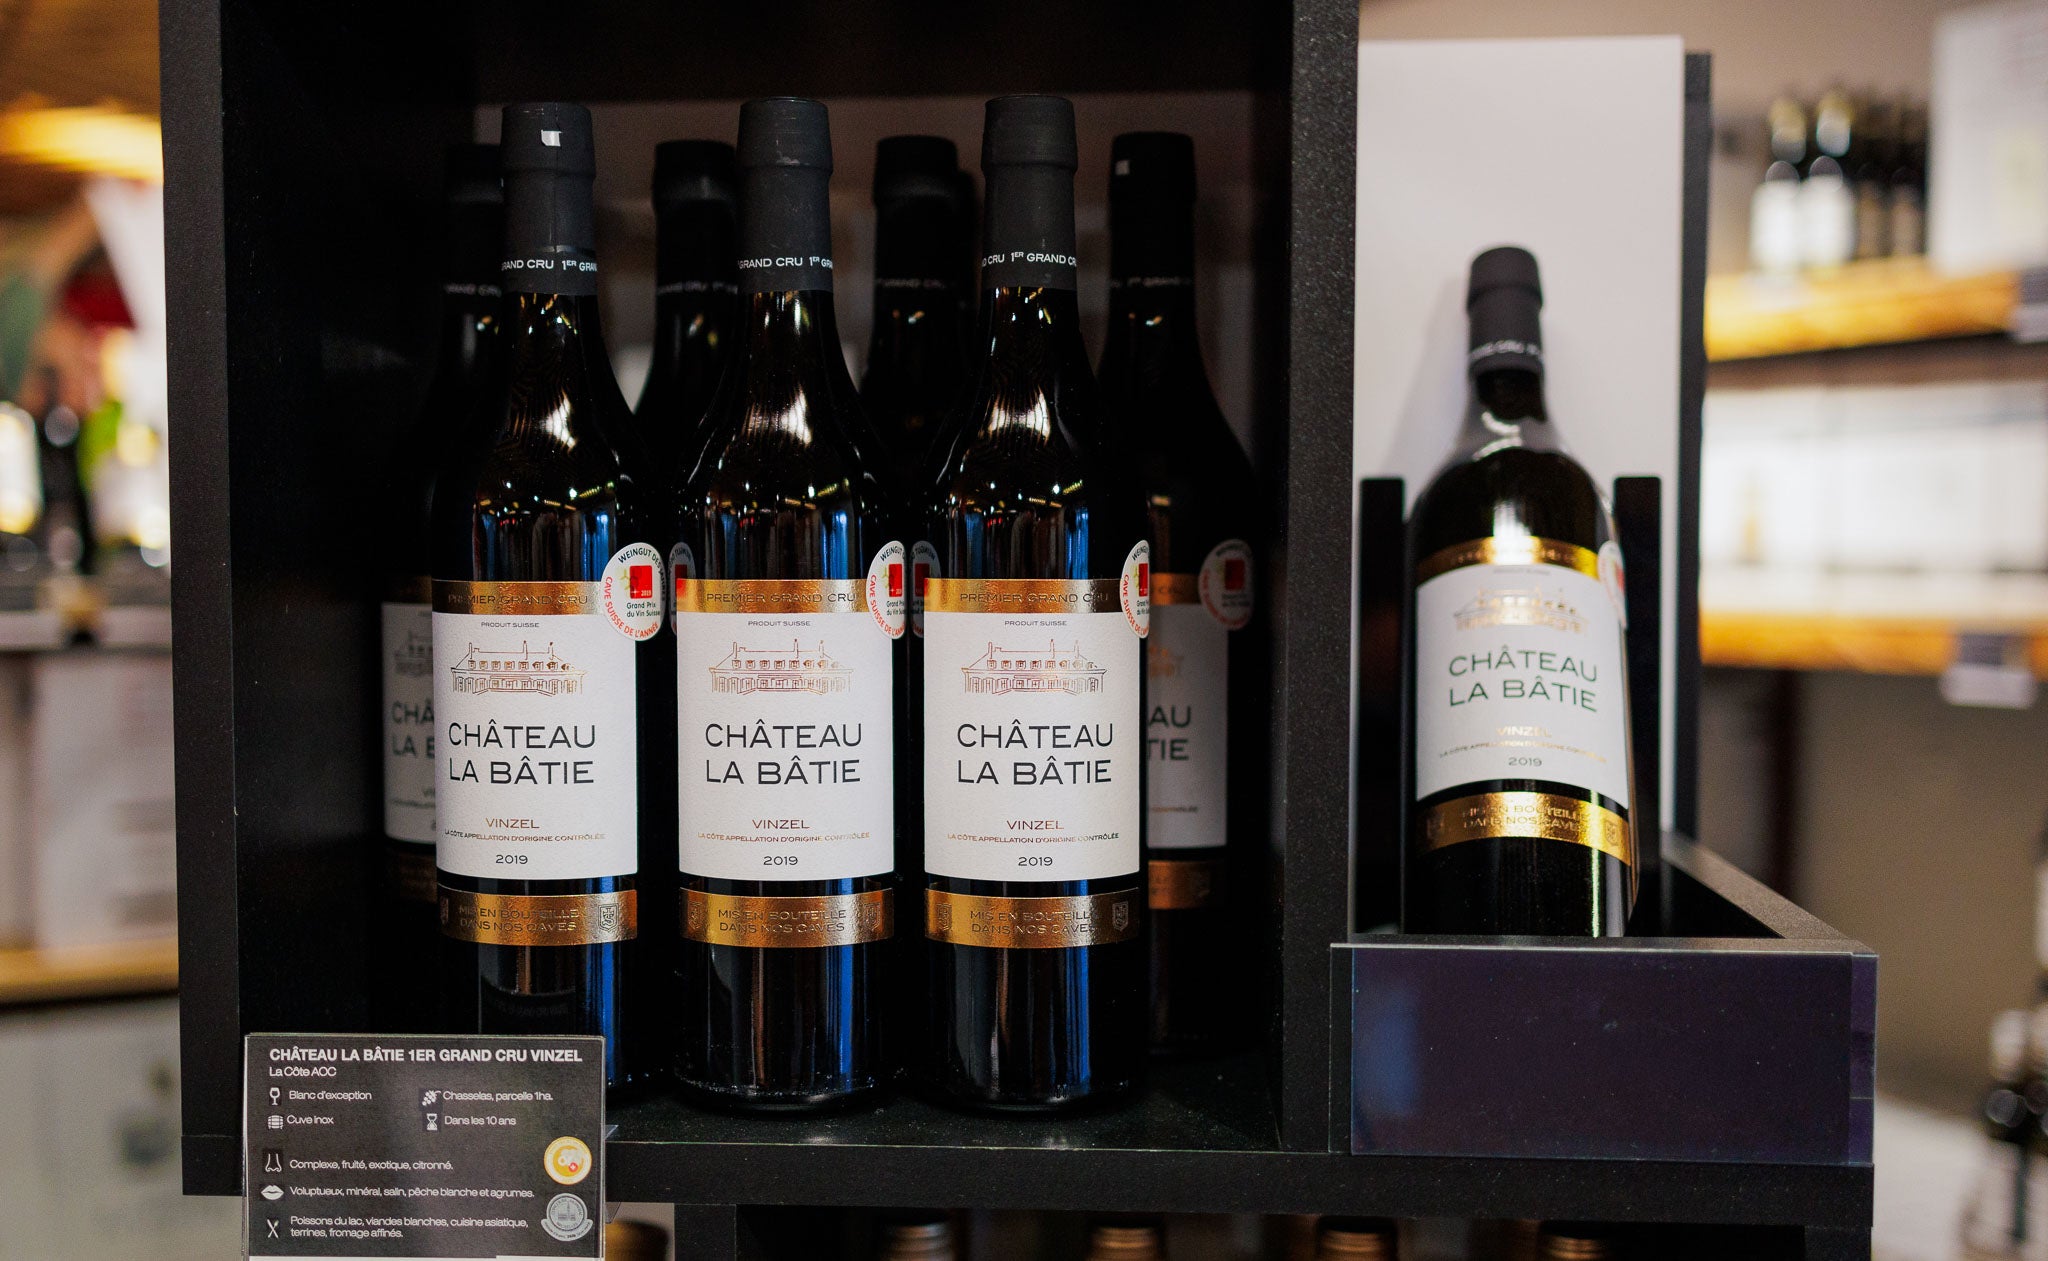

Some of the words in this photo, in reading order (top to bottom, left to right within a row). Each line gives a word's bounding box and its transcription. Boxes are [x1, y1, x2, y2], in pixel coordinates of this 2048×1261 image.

[739, 258, 772, 269] GRAND
[775, 257, 803, 266] CRU
[988, 254, 1004, 264] CRU
[1026, 253, 1066, 264] GRAND
[527, 260, 554, 269] CRU
[618, 548, 651, 563] WEINGUT
[604, 576, 612, 599] CAVE
[1122, 574, 1130, 597] CAVE
[500, 596, 550, 604] GRAND
[558, 595, 588, 604] CRU
[706, 593, 766, 603] PREMIER
[770, 594, 822, 603] GRAND
[827, 593, 856, 602] CRU
[960, 593, 1022, 603] PREMIER
[1028, 594, 1078, 603] GRAND
[606, 601, 624, 629] SUISSE
[870, 600, 884, 628] SUISSE
[884, 626, 892, 634] DE
[1124, 600, 1136, 626] SUISSE
[624, 626, 634, 636] DE
[1449, 644, 1597, 682] CHÂTEAU
[1450, 682, 1488, 706] LA
[1503, 675, 1597, 712] BÂTIE
[448, 719, 596, 748] CHÂTEAU
[706, 719, 862, 748] CHÂTEAU
[957, 718, 1113, 748] CHÂTEAU
[1497, 726, 1552, 738] VINZEL
[392, 736, 416, 756] LA
[1508, 756, 1542, 766] 2019
[450, 758, 478, 783] LA
[490, 756, 594, 784] BÂTIE
[706, 760, 744, 784] LA
[758, 755, 860, 784] BÂTIE
[958, 760, 999, 784] LA
[1013, 755, 1112, 785] BÂTIE
[486, 818, 540, 828] VINZEL
[752, 820, 810, 830] VINZEL
[1006, 820, 1064, 830] VINZEL
[450, 830, 464, 838] CÔTE
[464, 832, 510, 841] APPELLATION
[554, 833, 606, 842] CONTRÔLÉE
[706, 832, 724, 840] CÔTE
[958, 834, 977, 842] CÔTE
[1078, 832, 1119, 842] CONTRÔLÉE
[496, 854, 528, 864] 2019
[763, 856, 798, 866] 2019
[1018, 856, 1053, 866] 2019
[480, 908, 496, 918] EN
[500, 909, 579, 919] BOUTEILLE
[718, 910, 740, 919] MIS
[745, 911, 764, 920] EN
[769, 910, 846, 920] BOUTEILLE
[970, 910, 994, 920] MIS
[998, 912, 1018, 921] EN
[460, 920, 490, 930] DANS
[494, 922, 522, 932] NOS
[526, 922, 577, 932] CAVES
[720, 922, 756, 933] DANS
[762, 924, 792, 933] NOS
[796, 923, 844, 933] CAVES
[972, 923, 1010, 934] DANS
[1016, 925, 1047, 934] NOS
[270, 1046, 338, 1062] CHÂTEAU
[341, 1049, 360, 1062] LA
[363, 1046, 404, 1062] BÂTIE
[408, 1049, 436, 1062] 1ER
[440, 1050, 492, 1062] GRAND
[496, 1050, 528, 1062] CRU
[530, 1050, 582, 1062] VINZEL
[269, 1067, 282, 1076] La
[284, 1066, 310, 1076] Côte
[311, 1066, 336, 1076] AOC
[289, 1091, 315, 1100] Blanc
[316, 1091, 372, 1102] d'exception
[442, 1090, 494, 1101] Chasselas,
[496, 1091, 533, 1102] parcelle
[535, 1092, 554, 1100] 1ha.
[287, 1115, 312, 1124] Cuve
[314, 1116, 334, 1124] inox
[444, 1116, 470, 1125] Dans
[471, 1116, 484, 1125] les
[486, 1116, 497, 1124] 10
[290, 1160, 340, 1170] Complexe,
[342, 1160, 368, 1170] fruité,
[368, 1161, 411, 1171] exotique,
[412, 1160, 454, 1170] citronné.
[290, 1186, 344, 1196] Voluptueux,
[346, 1187, 382, 1196] minéral,
[384, 1188, 406, 1196] salin,
[408, 1188, 439, 1198] pêche
[440, 1188, 478, 1196] blanche
[479, 1188, 490, 1196] et
[490, 1189, 534, 1198] agrumes.
[290, 1216, 333, 1226] Poissons
[334, 1216, 348, 1226] du
[348, 1216, 364, 1226] lac,
[366, 1216, 402, 1226] viandes
[404, 1217, 449, 1227] blanches,
[450, 1218, 484, 1227] cuisine
[484, 1218, 528, 1228] asiatique,
[291, 1228, 328, 1238] terrines,
[329, 1228, 370, 1238] fromage
[370, 1228, 404, 1238] affinés.
